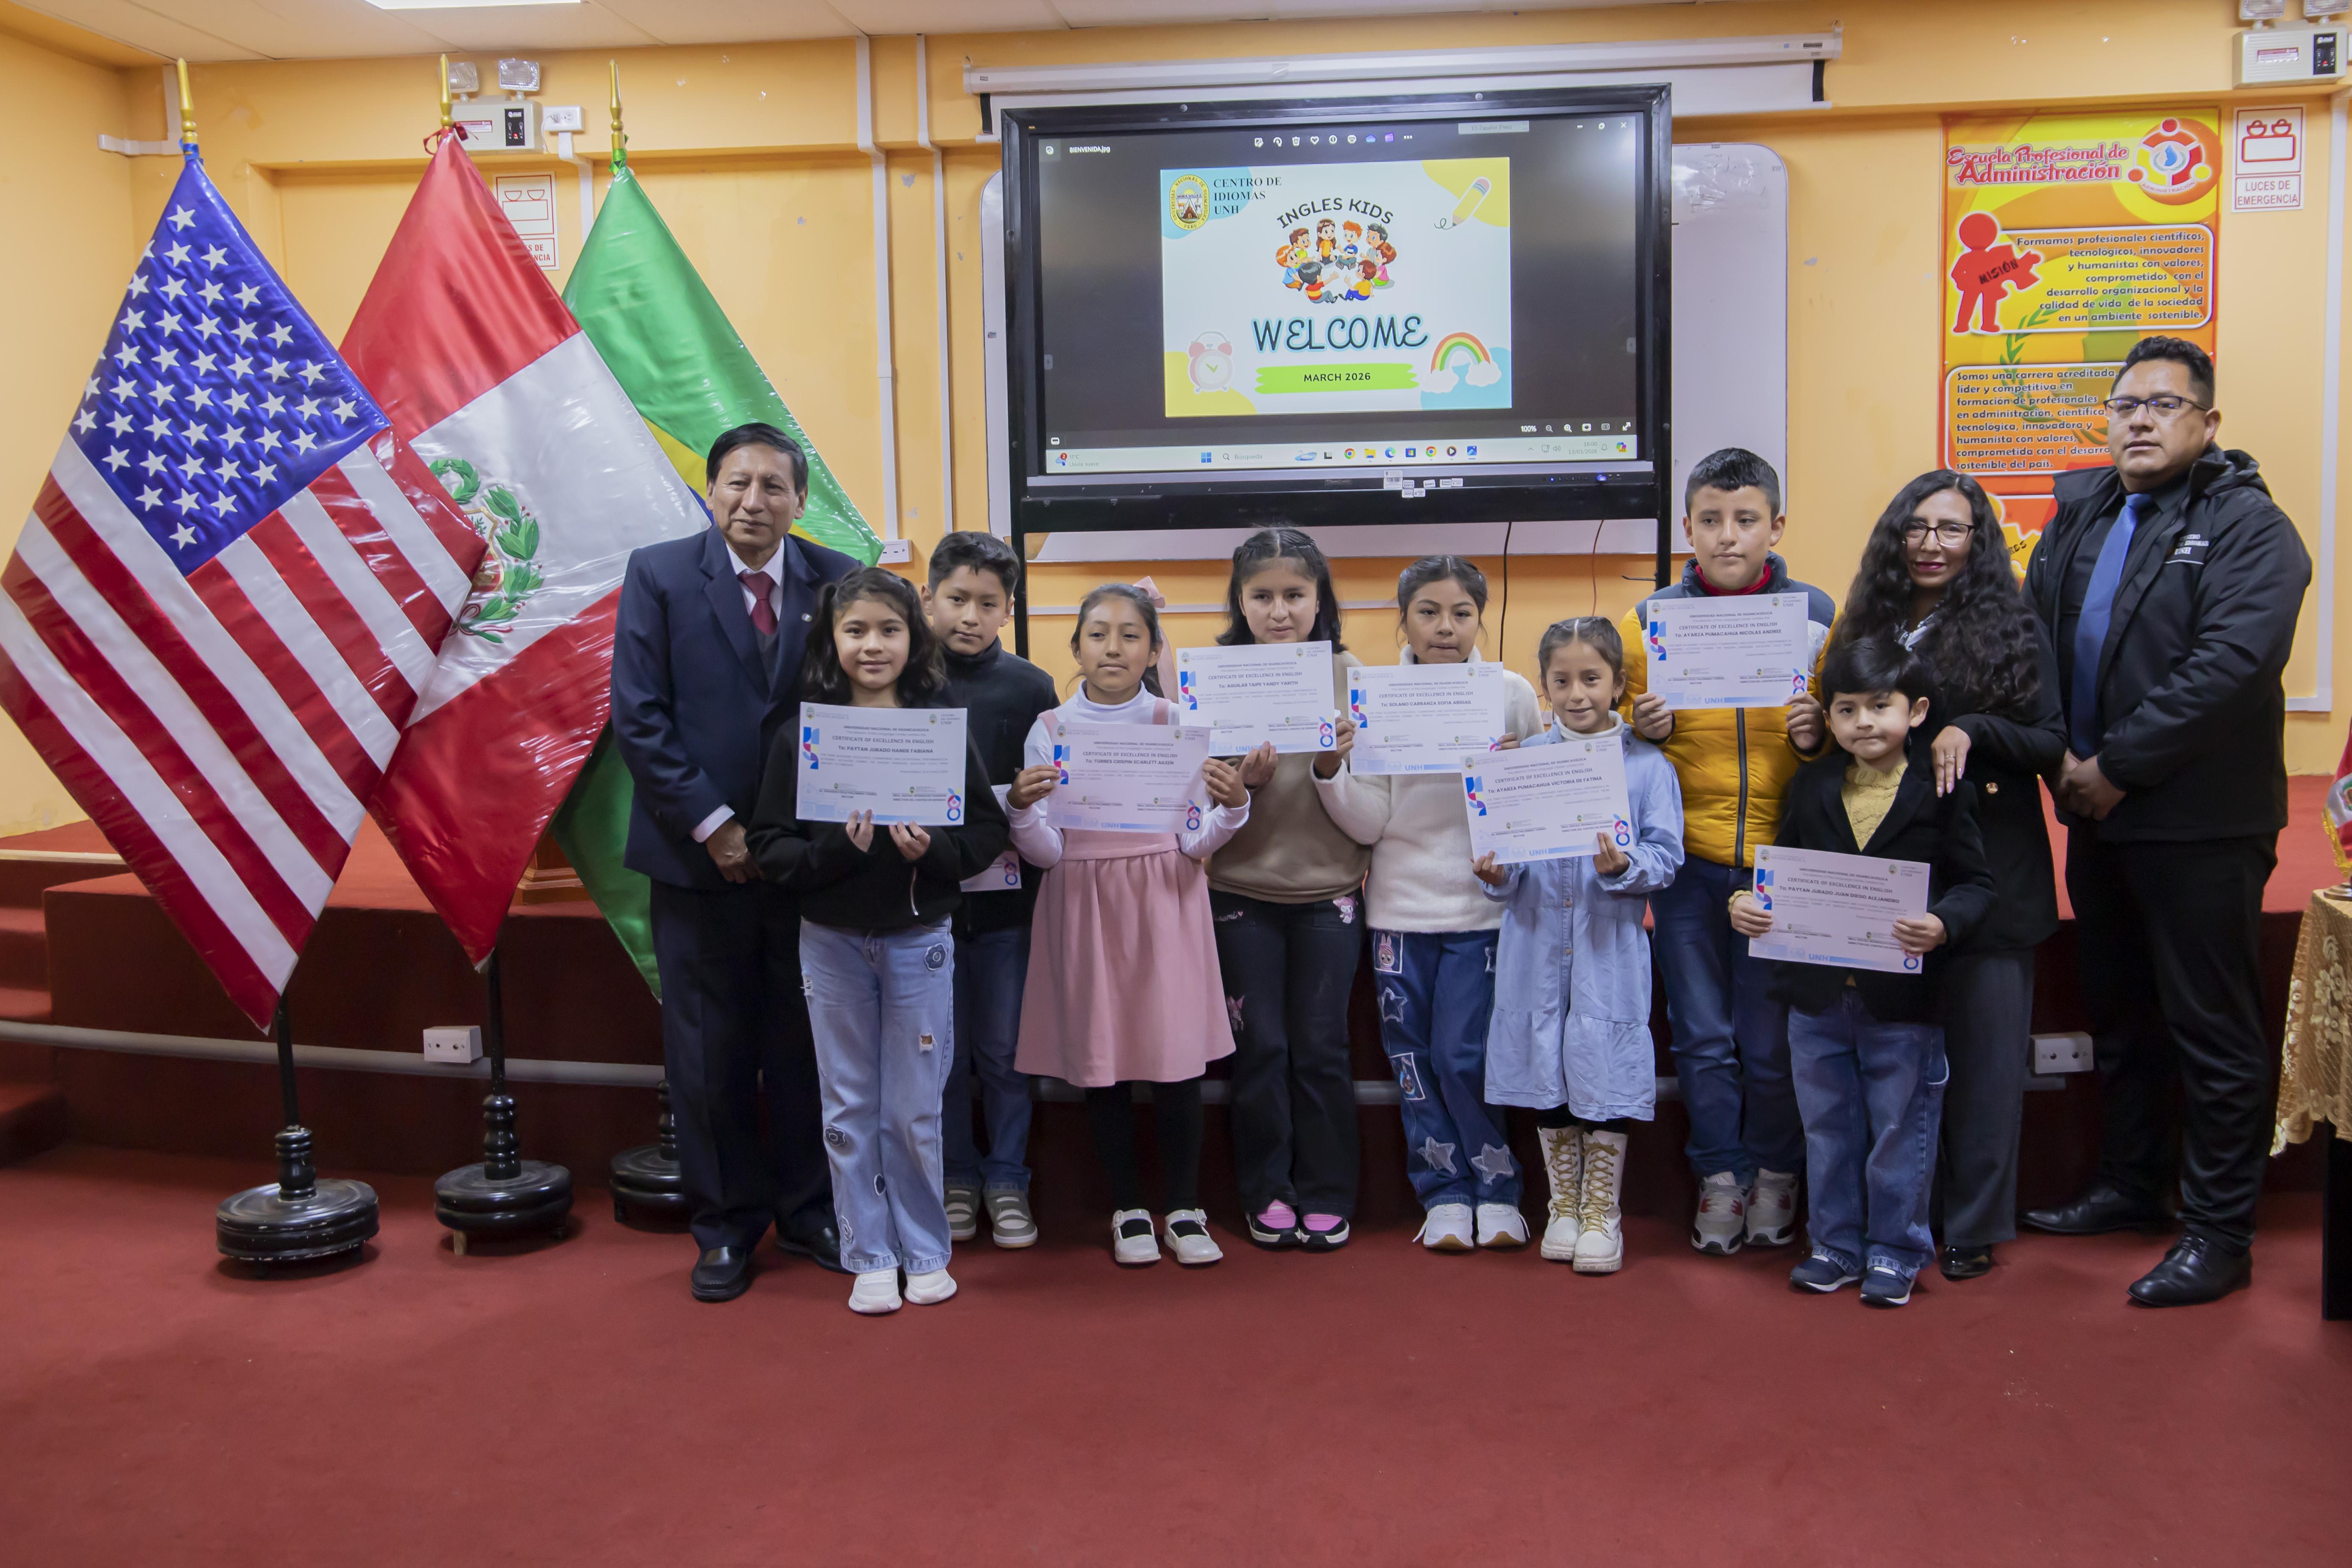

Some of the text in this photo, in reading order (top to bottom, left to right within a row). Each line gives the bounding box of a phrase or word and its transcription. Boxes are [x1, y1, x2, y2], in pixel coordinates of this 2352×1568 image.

[1069, 145, 1111, 153] BIENVENIDA.jpg
[1948, 142, 2128, 165] Escuela Profesional de
[1956, 160, 2121, 184] Administración
[1175, 176, 1198, 187] NACIONAL
[1214, 177, 1282, 187] CENTRO DE
[2246, 180, 2290, 191] LUCES DE
[1214, 191, 1265, 201] IDIOMAS
[2238, 194, 2298, 205] EMERGENCIA
[1214, 205, 1239, 214] UNH
[1277, 198, 1393, 228] INGLES KIDS
[2017, 237, 2074, 246] Formamos
[2078, 233, 2147, 245] profesionales
[2070, 245, 2204, 258] tecnológicos, innovadores
[2068, 258, 2204, 272] y humanistas con valores,
[2086, 272, 2167, 283] comprometidos
[2195, 271, 2204, 280] el
[2047, 287, 2099, 296] desarrollo
[2102, 285, 2181, 296] organizacional
[2193, 284, 2203, 292] la
[2040, 296, 2203, 309] calidad de vida de la sociedad
[2091, 311, 2142, 320] ambiente
[2148, 310, 2203, 320] sostenible.
[1252, 315, 1429, 351] WELCOME
[1304, 373, 1371, 382] MARCH 2026
[1957, 372, 1989, 381] Somos
[1957, 385, 1980, 394] líder
[1993, 384, 2056, 393] competitiva
[1957, 395, 2098, 406] formación de profesionales
[1973, 408, 2054, 418] administración,
[1957, 422, 2018, 432] tecnológica,
[2022, 421, 2083, 430] innovadora
[1957, 435, 2012, 444] humanista
[2037, 434, 2078, 443] valores,
[1234, 453, 1263, 461] Búsqueda
[1957, 447, 2034, 457] comprometida
[2057, 446, 2066, 454] el
[2071, 446, 2110, 455] desarro
[1957, 460, 2053, 470] sostenible del país.
